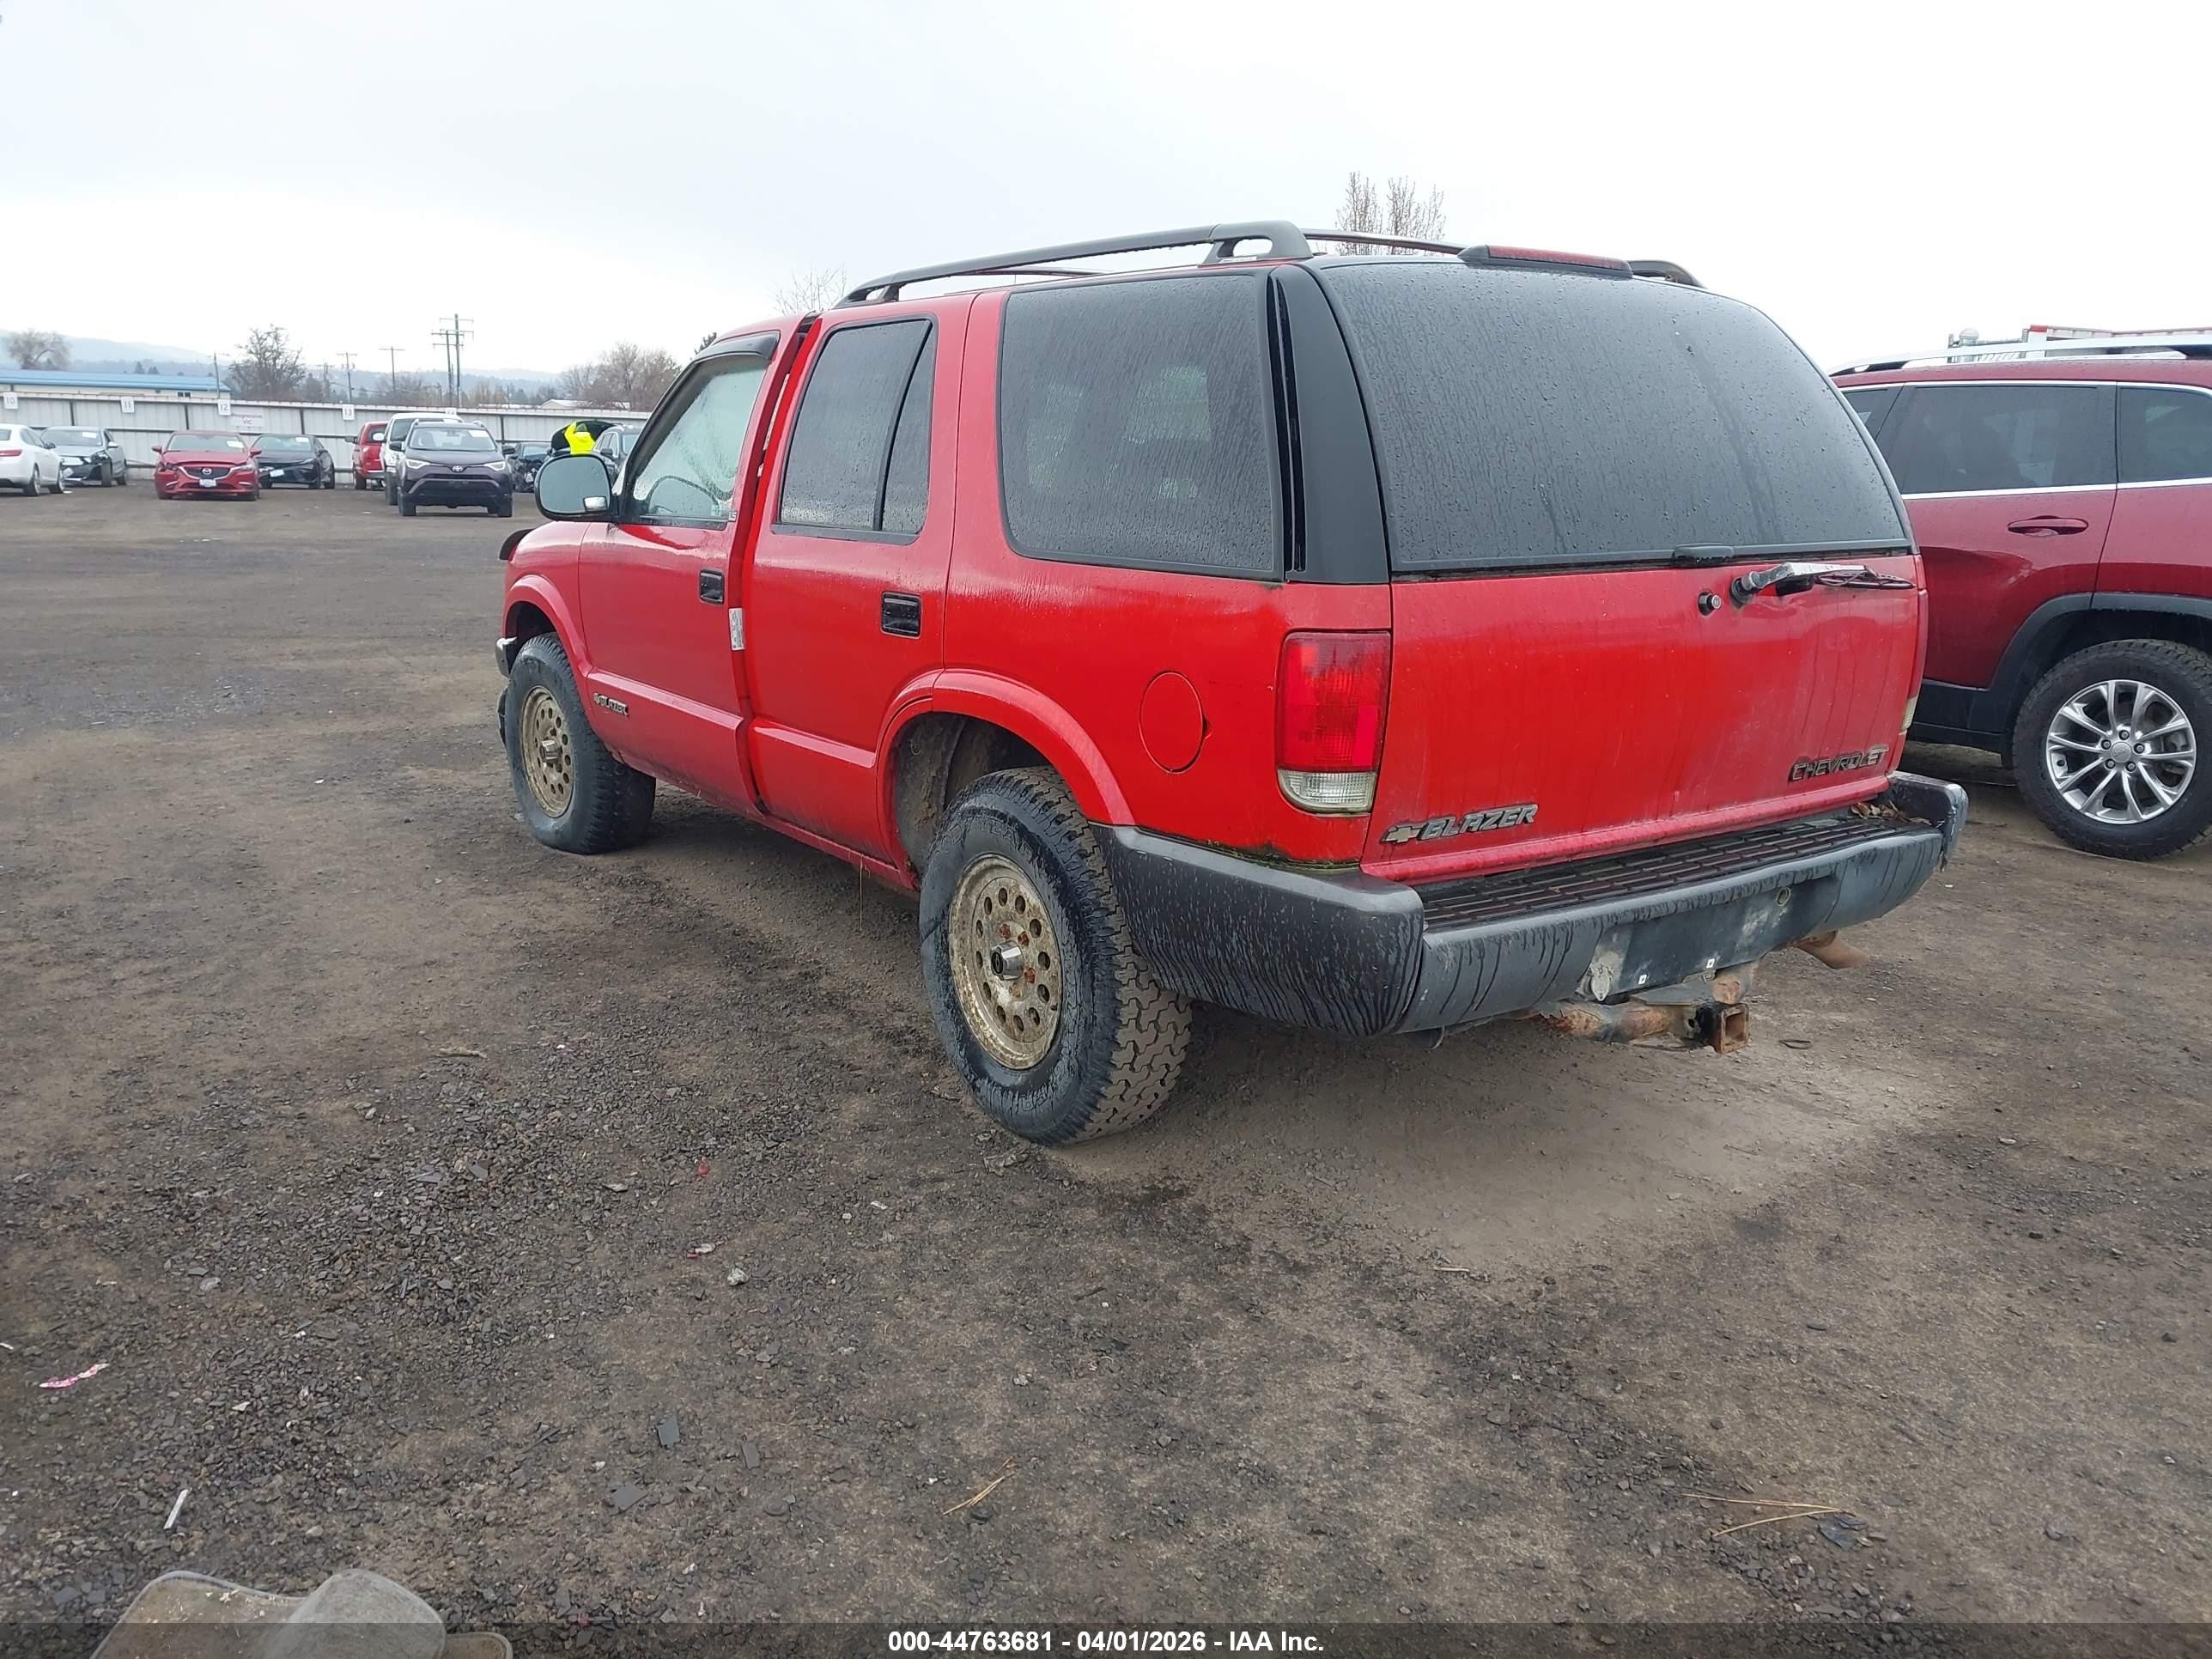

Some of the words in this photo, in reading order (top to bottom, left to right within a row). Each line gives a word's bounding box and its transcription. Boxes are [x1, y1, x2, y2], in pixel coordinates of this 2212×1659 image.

[220, 404, 229, 412] 12
[343, 408, 353, 416] 13
[1789, 749, 1889, 781] CHEVROLET
[1420, 804, 1538, 841] BLAZER
